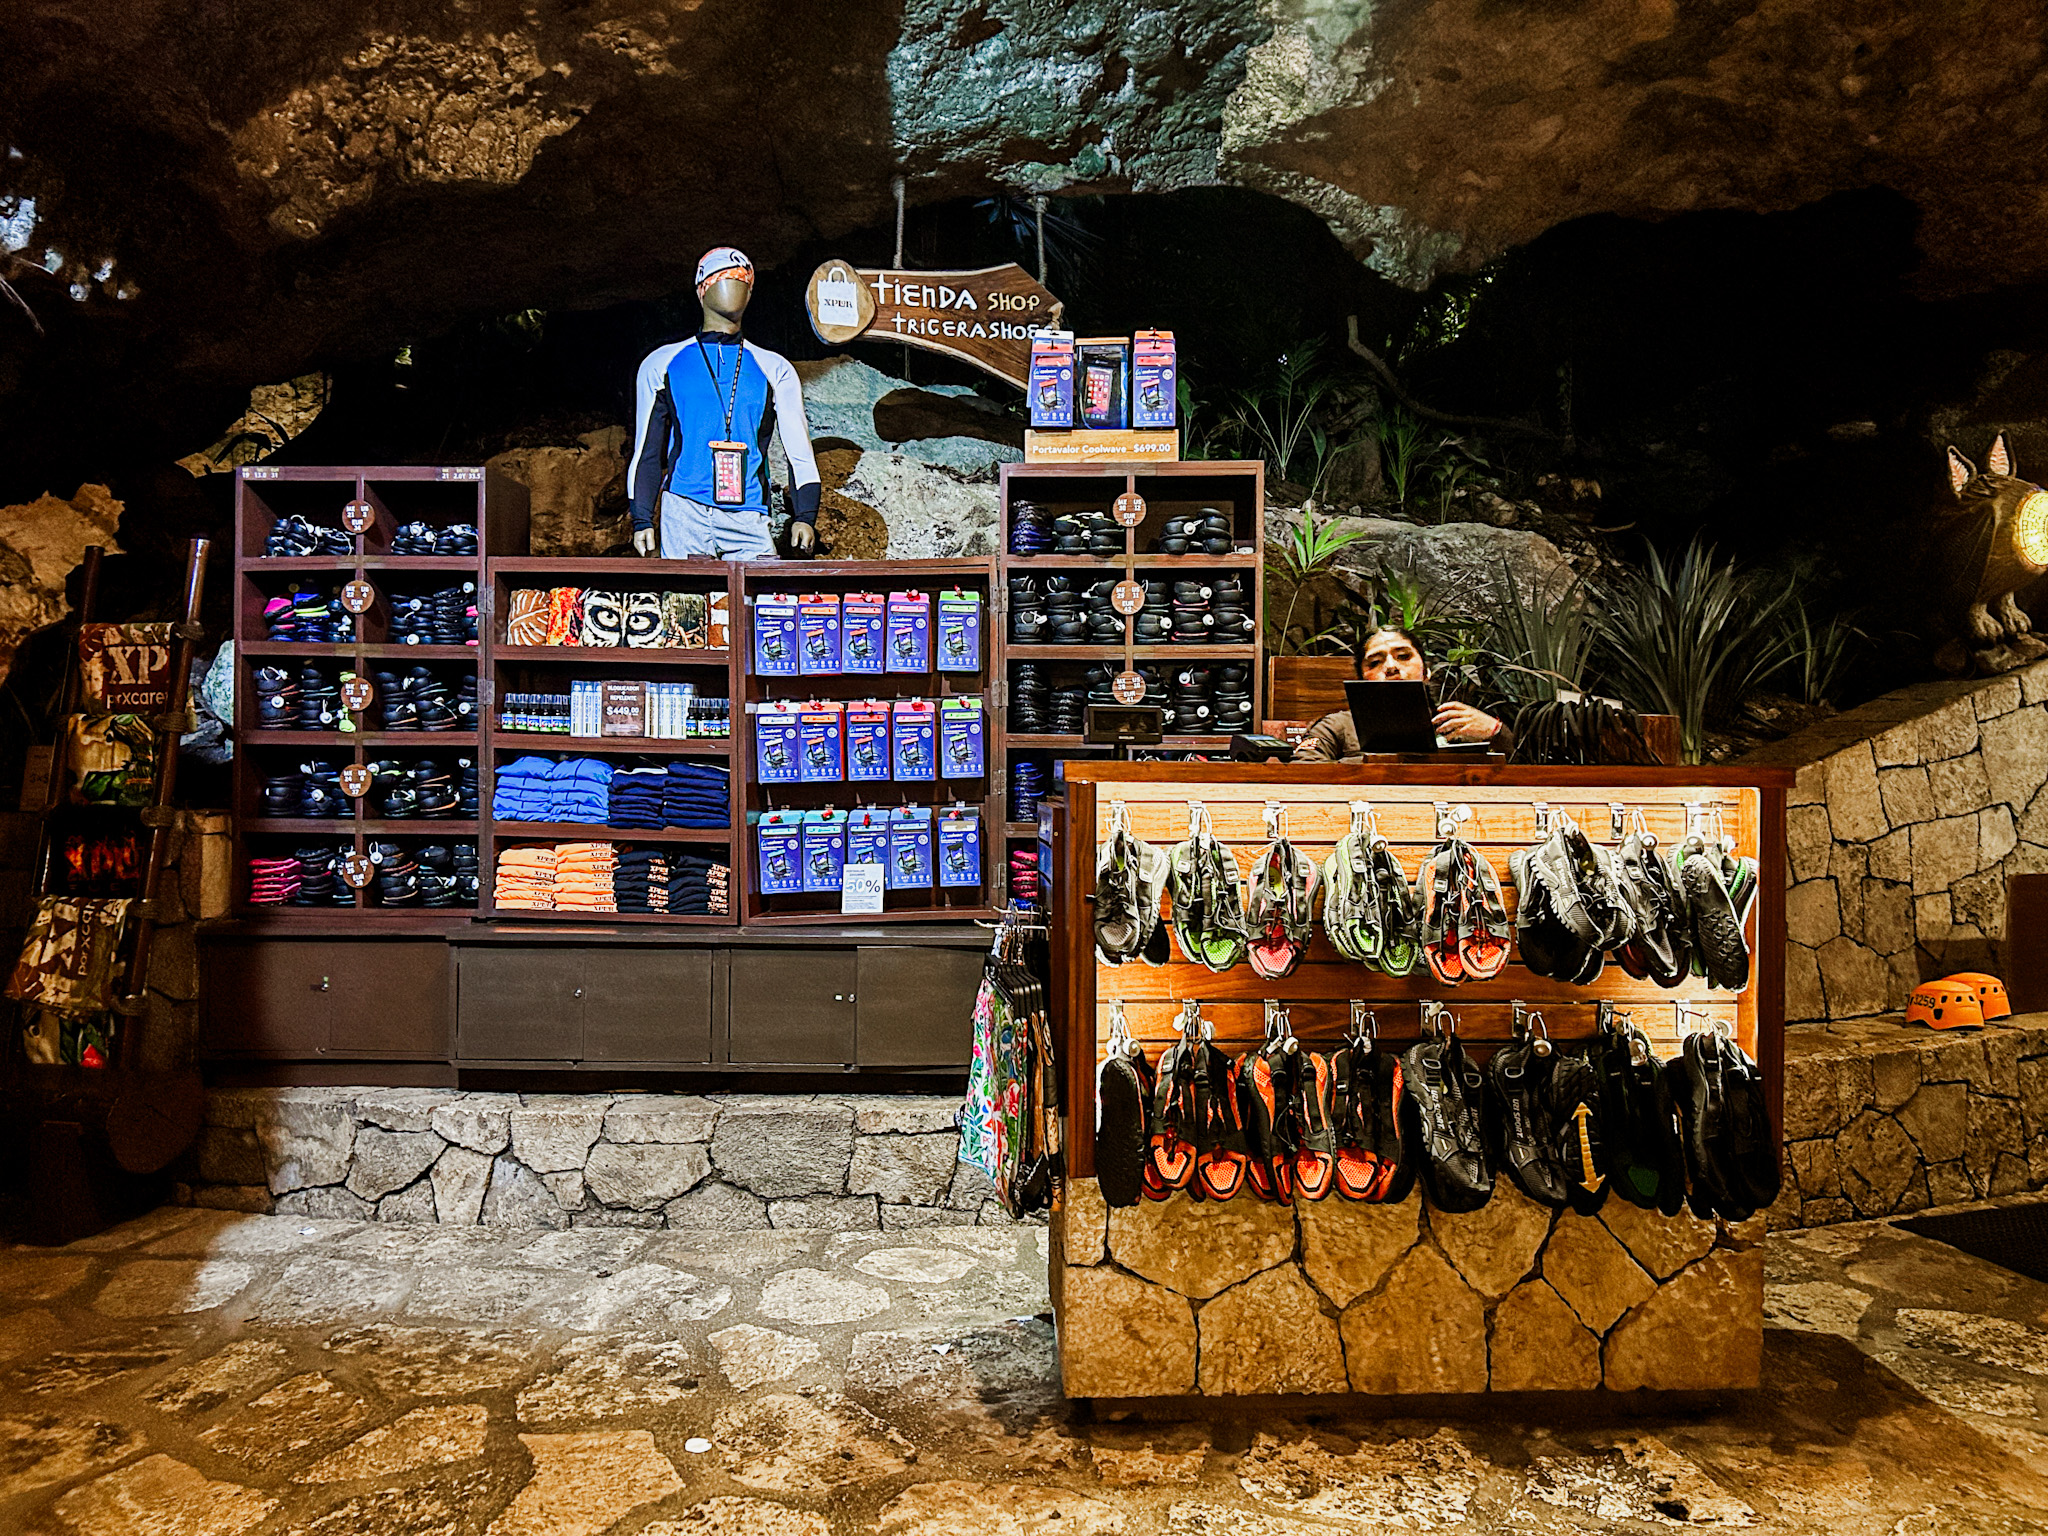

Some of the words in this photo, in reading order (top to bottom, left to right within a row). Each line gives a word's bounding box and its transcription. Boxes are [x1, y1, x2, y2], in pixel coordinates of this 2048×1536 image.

[987, 292, 1040, 311] SHOP
[1032, 445, 1079, 454] Portavalor
[1081, 444, 1127, 454] Coolwave
[1133, 443, 1171, 453] $699.00
[846, 879, 880, 893] 50%
[1434, 1103, 1445, 1130] SPORT
[1513, 1111, 1523, 1138] SPORT
